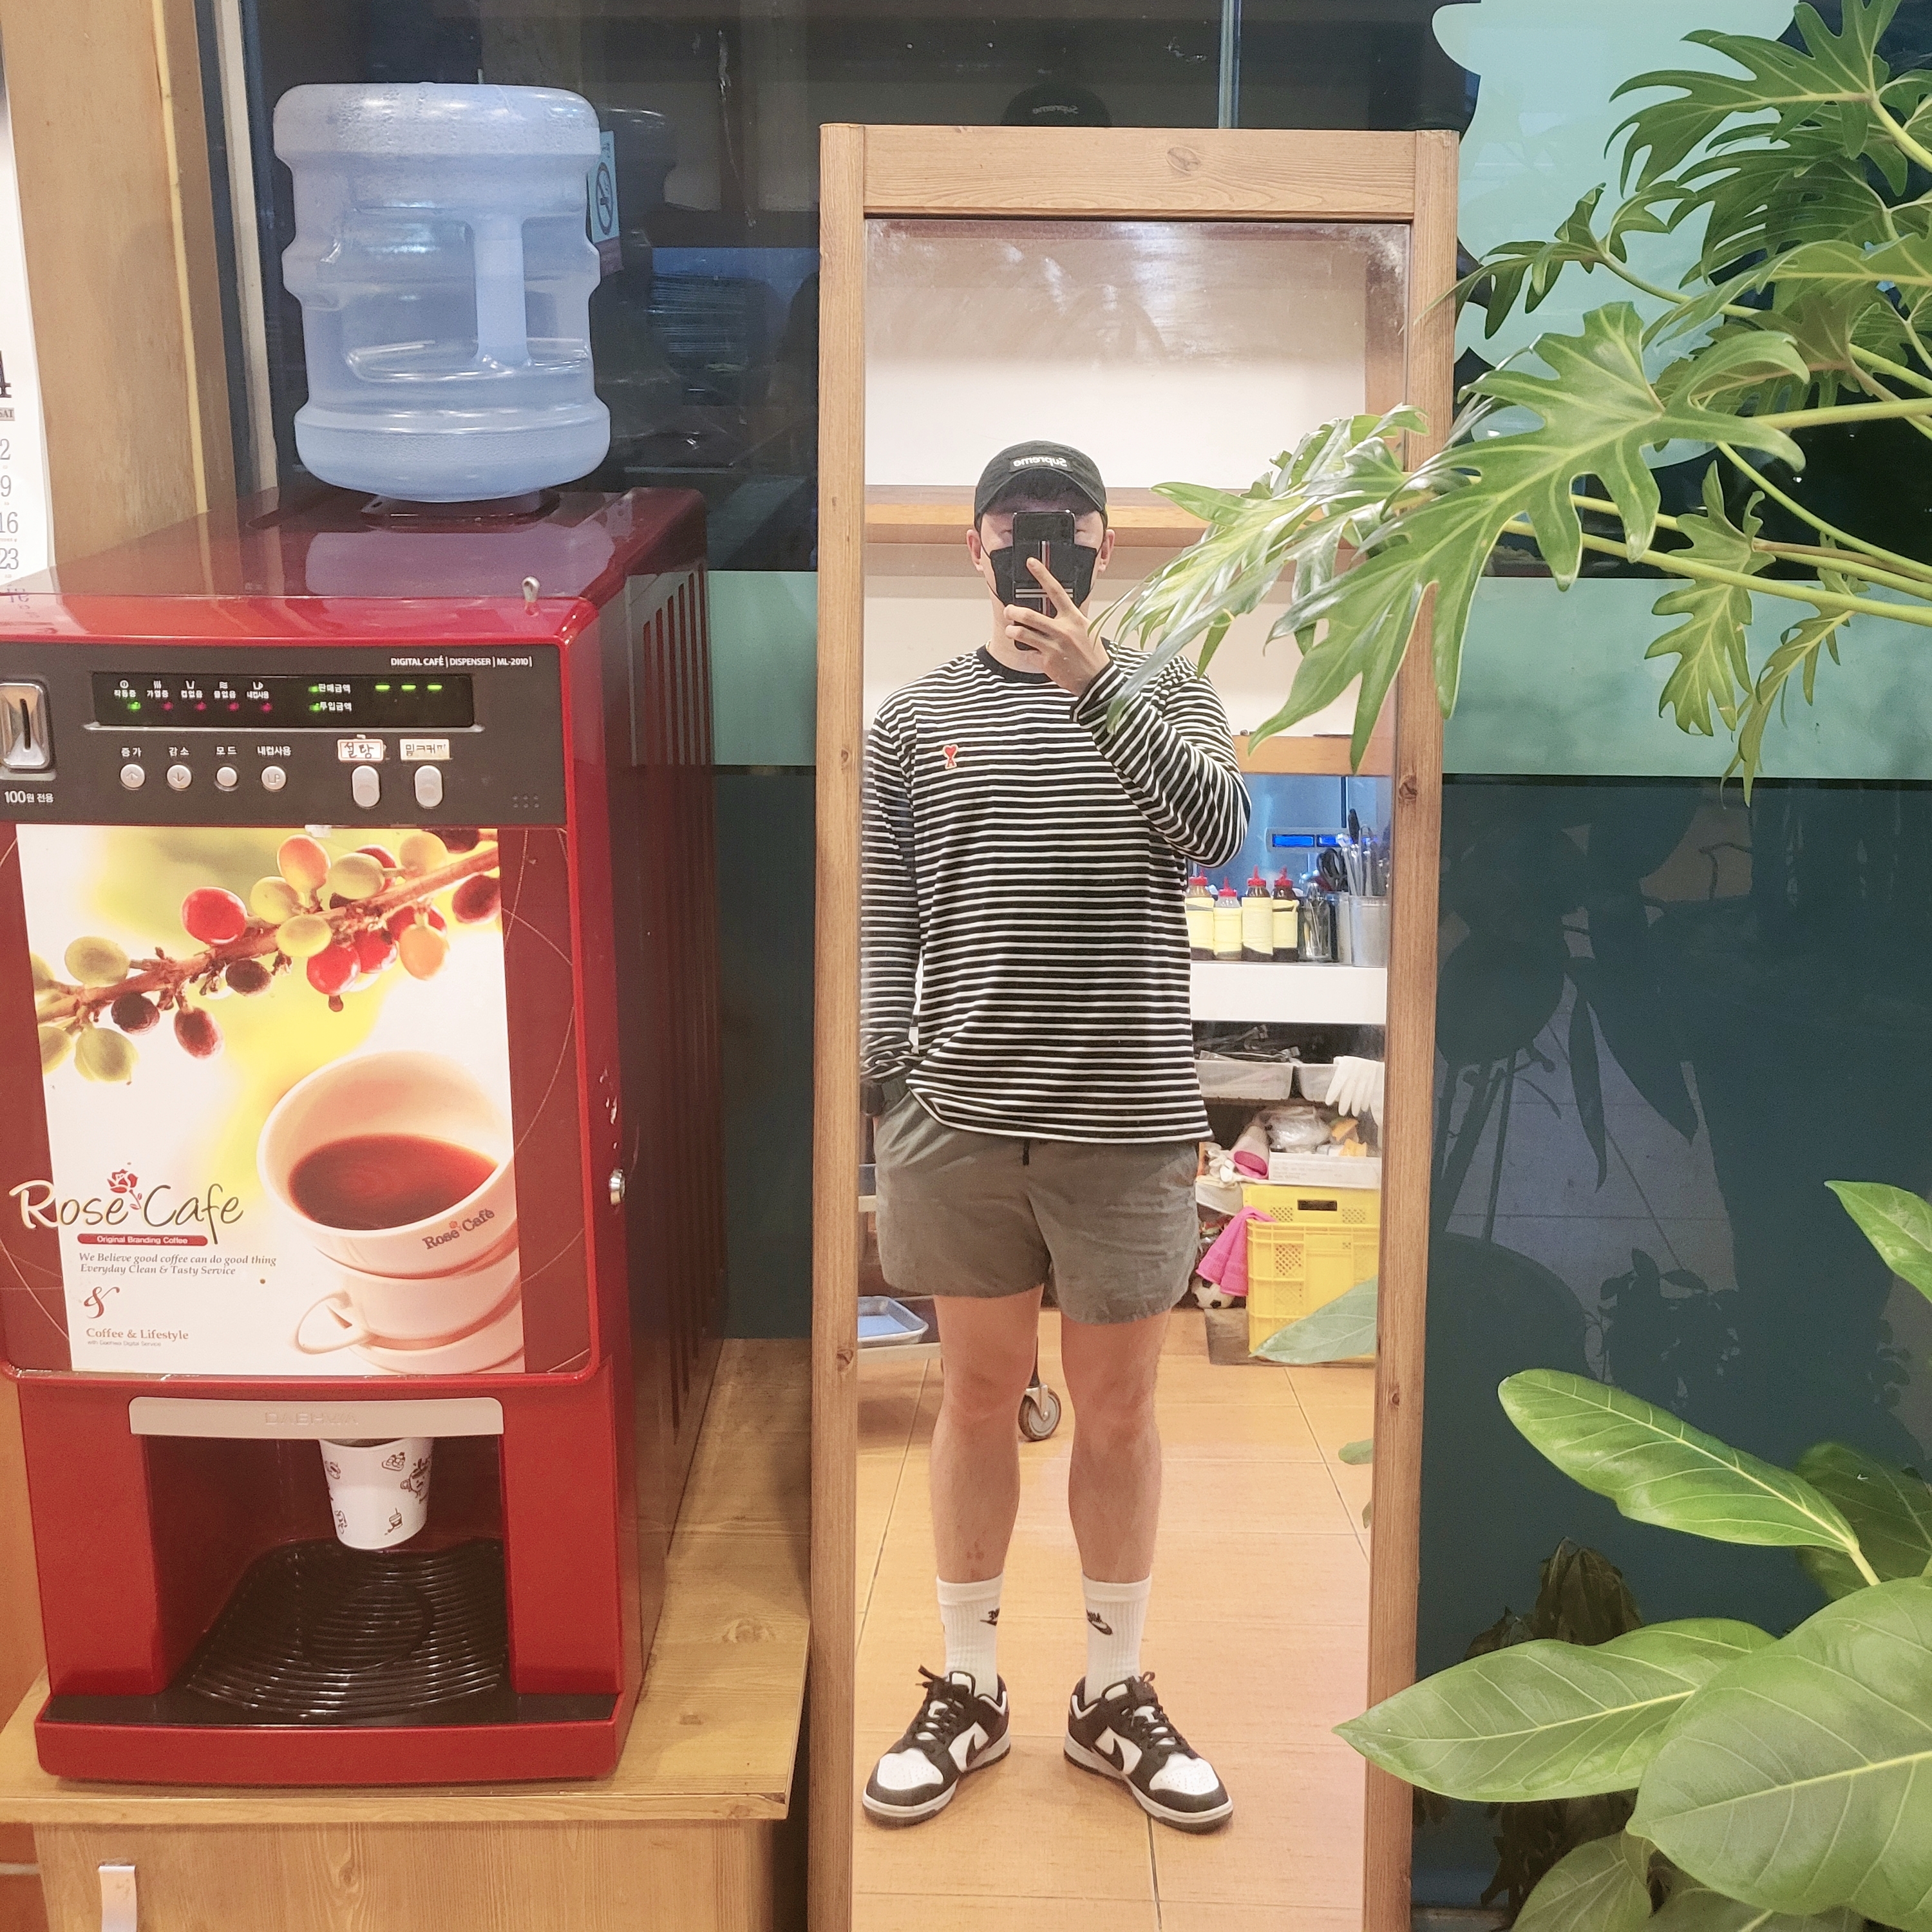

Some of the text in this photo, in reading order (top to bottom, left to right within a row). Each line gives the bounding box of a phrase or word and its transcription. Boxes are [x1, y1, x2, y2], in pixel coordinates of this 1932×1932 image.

[1, 475, 12, 497] 9
[390, 655, 444, 666] DIGITAL CAFÉ
[450, 658, 491, 666] DISPENSER
[497, 658, 529, 666] ML-2010
[318, 683, 351, 694] 판매금액
[319, 701, 352, 712] 투입금액
[121, 747, 142, 757] 증가
[169, 747, 190, 757] 감소
[216, 746, 237, 755] 모드
[258, 746, 292, 756] 내컵사용
[345, 742, 374, 759] 설탕
[5, 790, 54, 804] 100원 전용
[9, 1179, 243, 1245] Rose Cafe
[97, 1235, 126, 1244] Original
[422, 1229, 460, 1249] Rose
[79, 1253, 95, 1262] We
[97, 1253, 131, 1262] Believe
[134, 1255, 158, 1264] good
[160, 1254, 188, 1264] coffee
[210, 1255, 222, 1264] do
[224, 1255, 248, 1265] good
[251, 1256, 276, 1267] thing
[80, 1264, 126, 1274] Everyday
[129, 1265, 156, 1274] Clean
[171, 1265, 198, 1276] Tasty
[201, 1266, 236, 1274] Service
[86, 1328, 189, 1342] Coffee & Lifestyle
